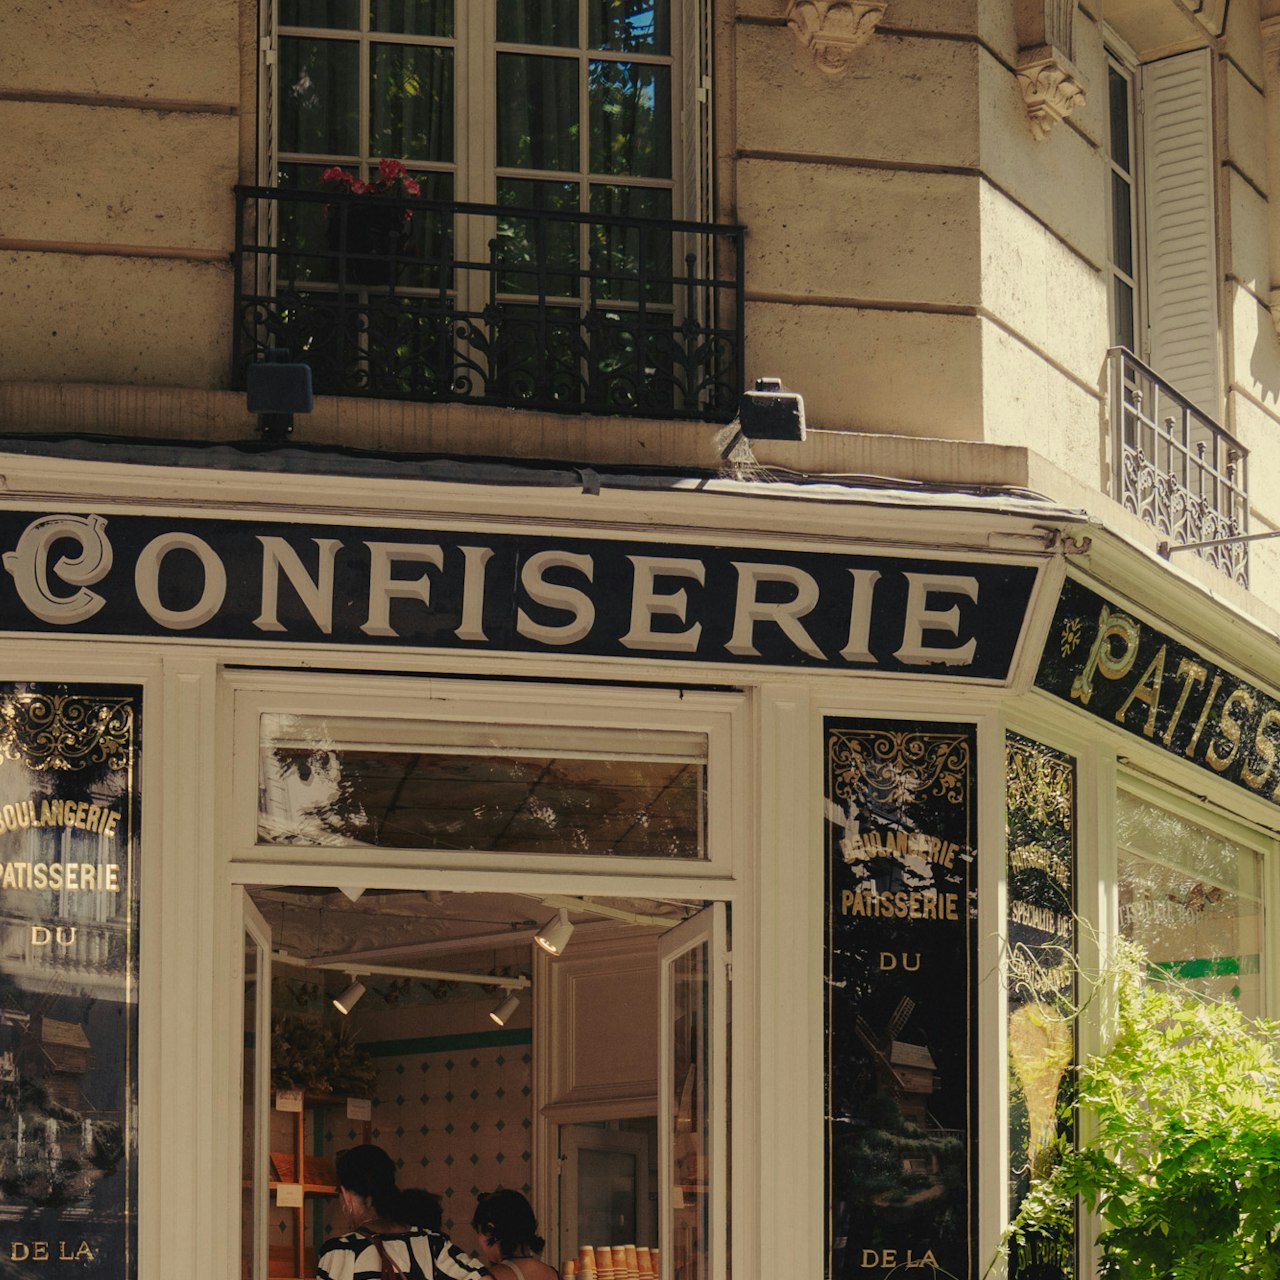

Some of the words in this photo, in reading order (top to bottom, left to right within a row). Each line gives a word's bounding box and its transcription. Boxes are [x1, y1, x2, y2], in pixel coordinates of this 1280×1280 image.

[3, 511, 980, 666] CONFISERIE
[840, 830, 960, 869] BOULANGERIE
[841, 889, 959, 921] PATISSERIE
[30, 926, 78, 946] DU
[879, 952, 922, 972] DU
[10, 1241, 49, 1261] DE
[59, 1240, 96, 1261] LA
[860, 1249, 897, 1269] DE
[906, 1248, 940, 1269] LA
